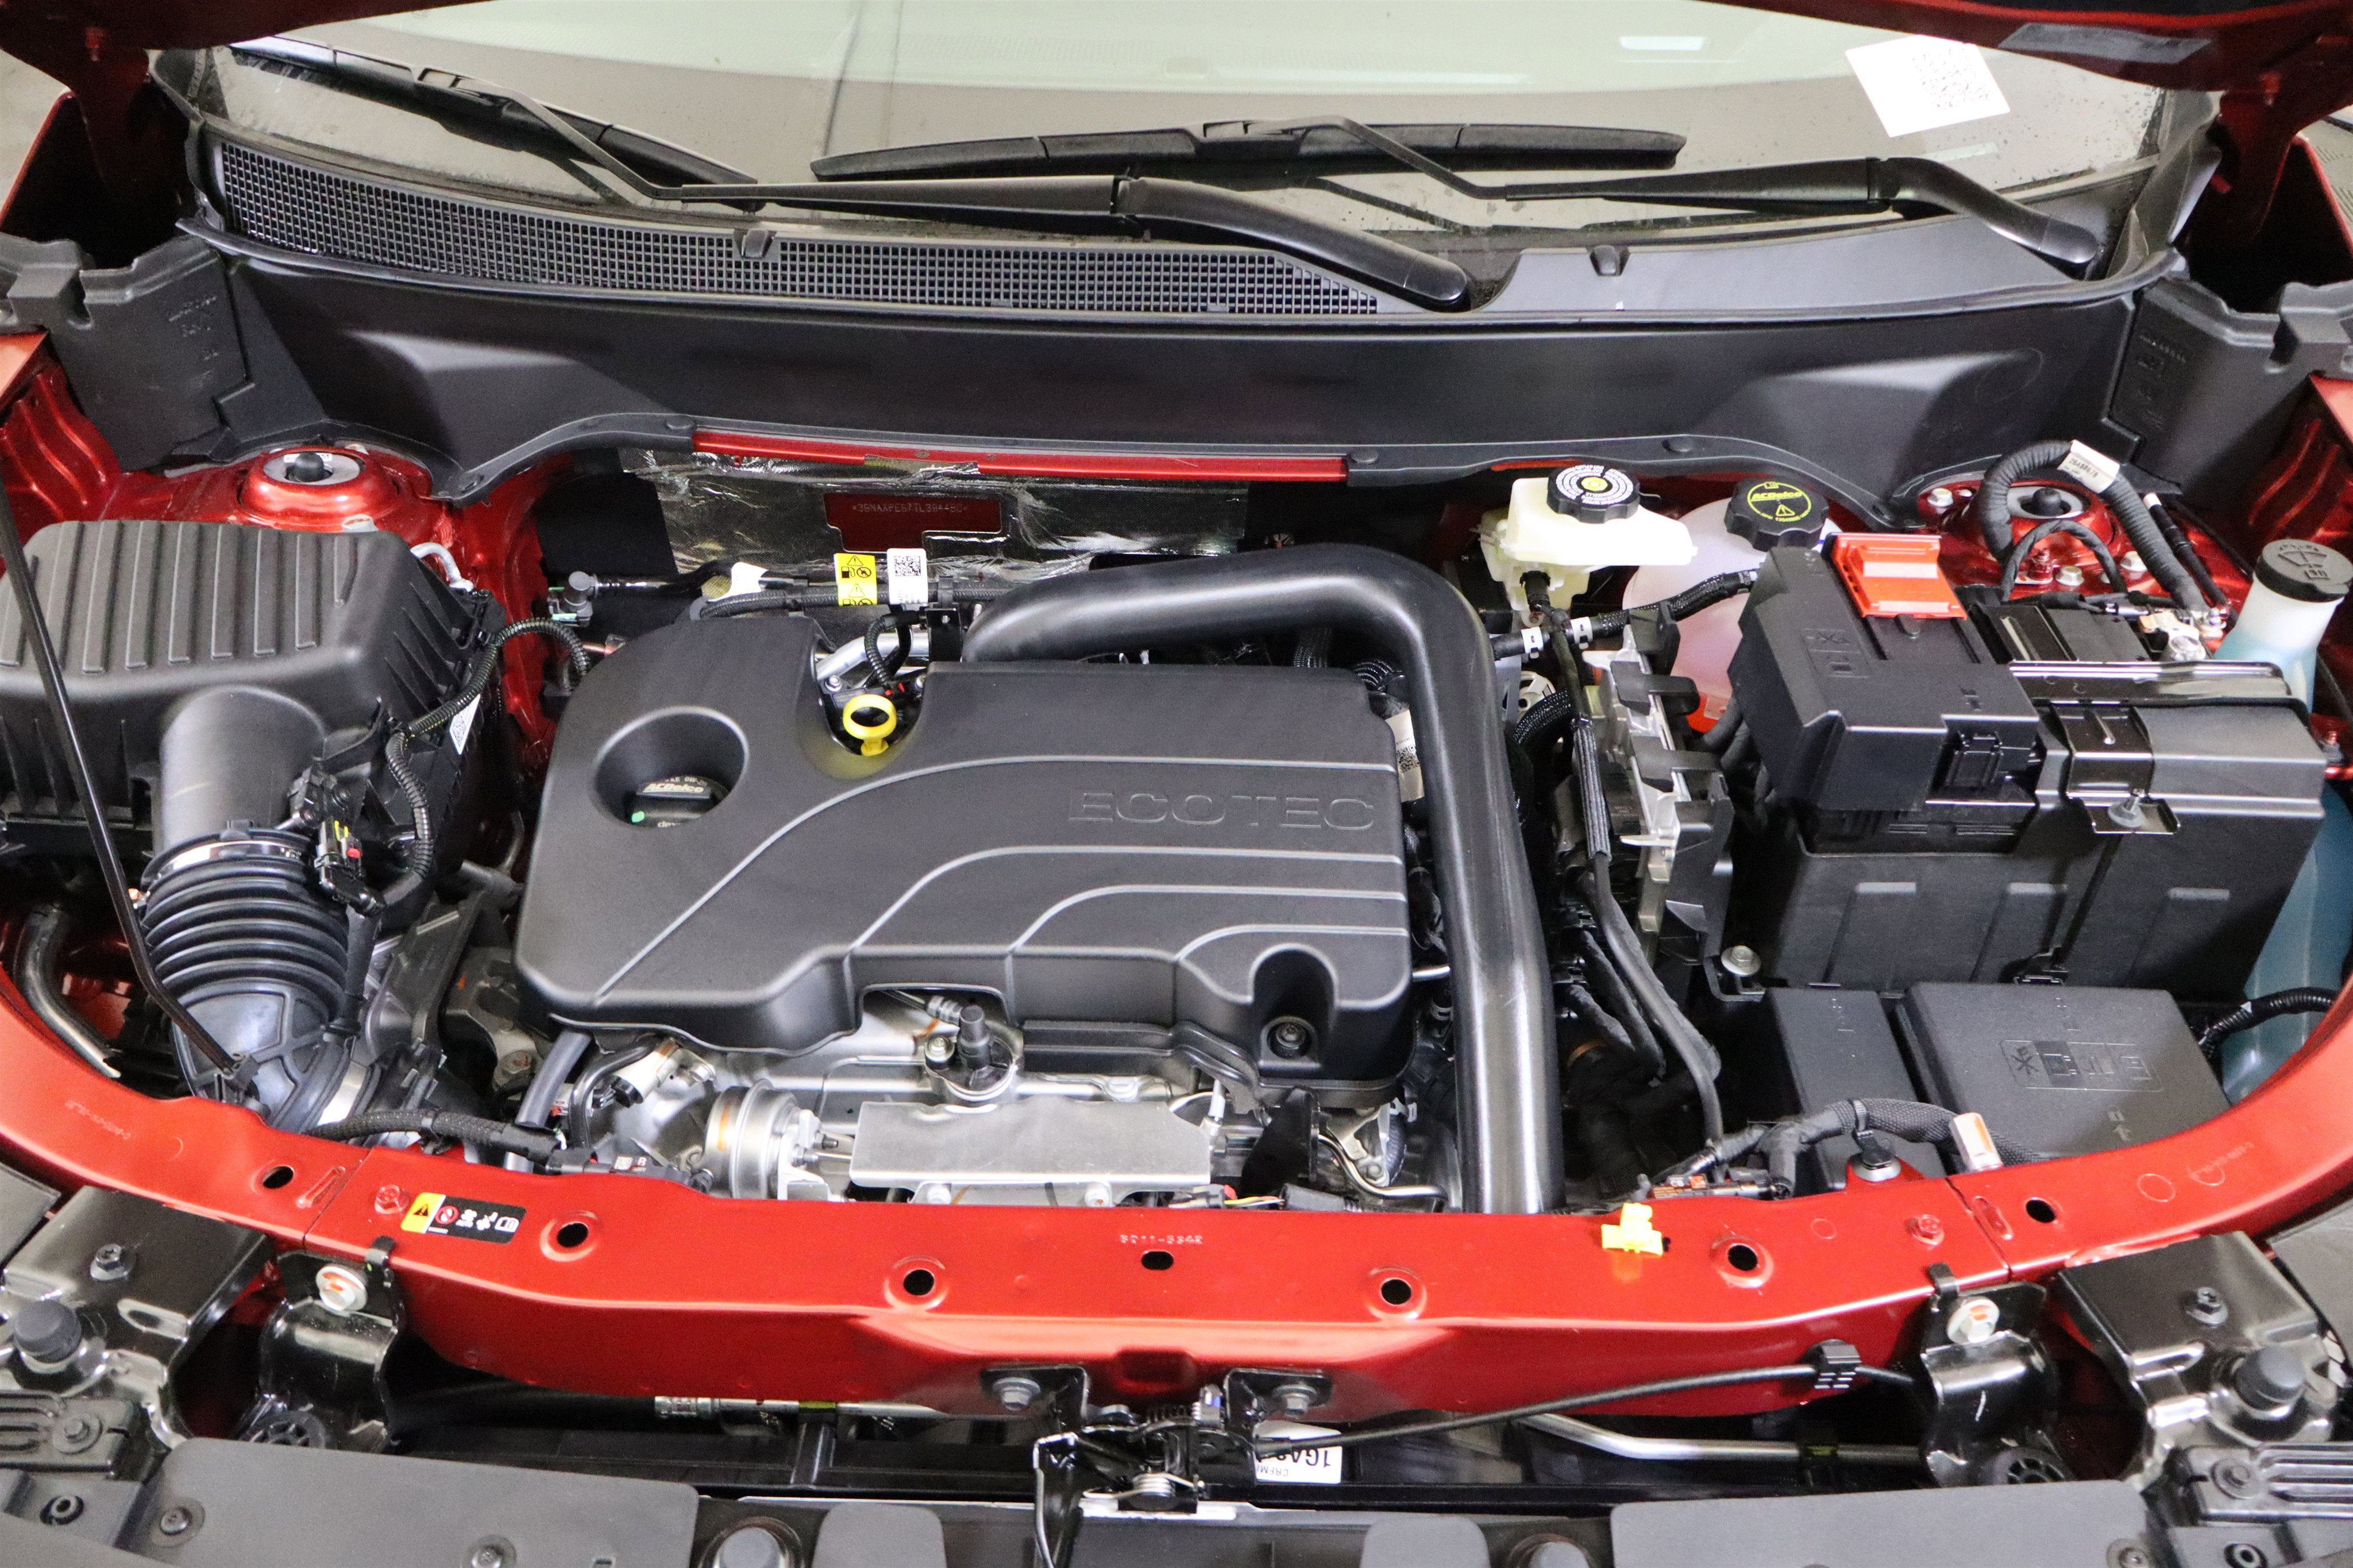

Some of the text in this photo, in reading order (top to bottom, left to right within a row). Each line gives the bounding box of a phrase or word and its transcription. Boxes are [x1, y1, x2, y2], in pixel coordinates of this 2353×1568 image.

[1751, 491, 1803, 500] ACDelco
[642, 783, 704, 793] ACDelco
[1069, 789, 1375, 831] ECOTEC
